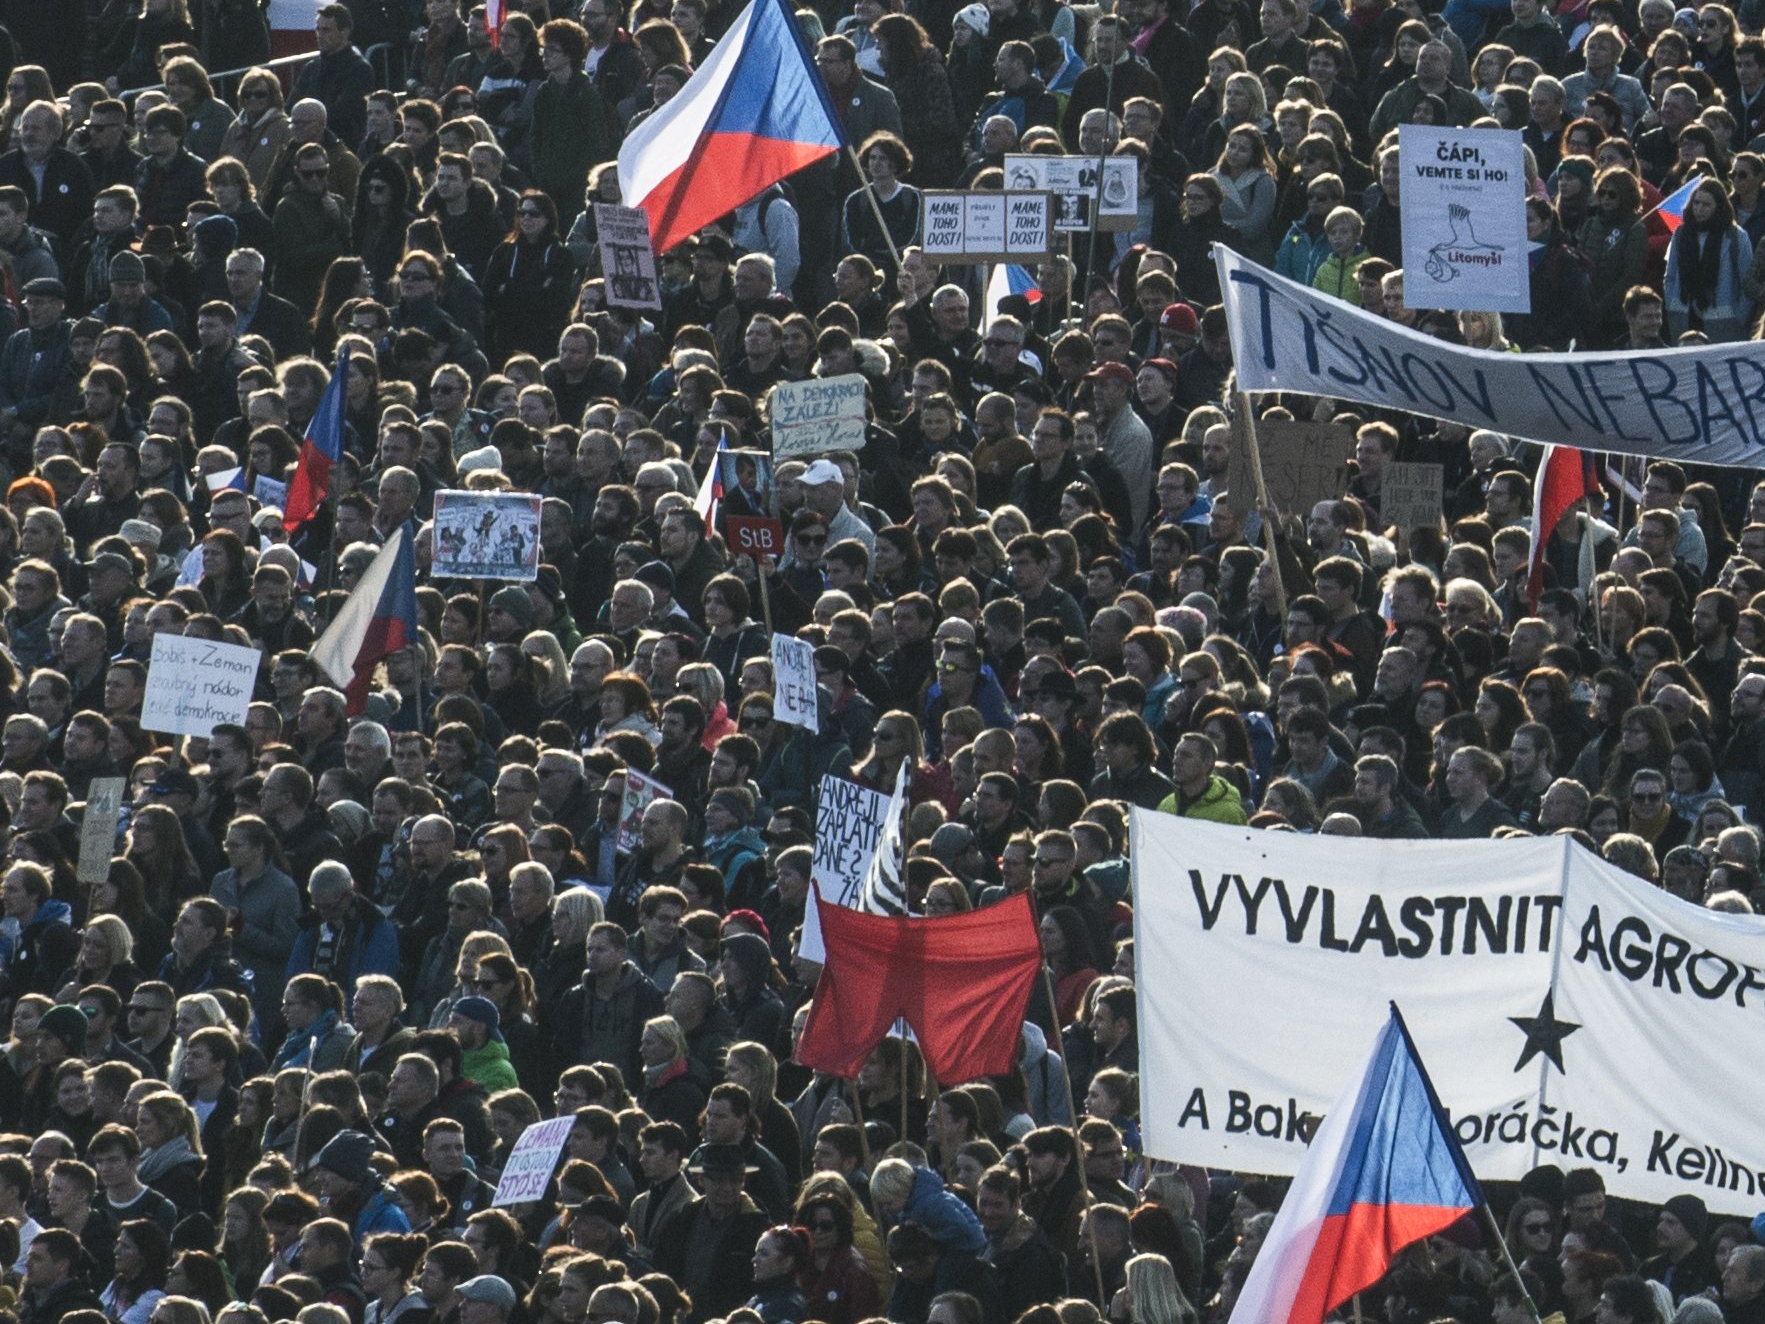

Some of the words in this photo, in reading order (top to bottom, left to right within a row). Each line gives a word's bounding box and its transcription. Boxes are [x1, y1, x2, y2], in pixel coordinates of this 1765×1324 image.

[1436, 141, 1487, 169] ČÁPI,
[1415, 167, 1463, 183] VEMTE
[1466, 169, 1480, 183] SI
[1482, 169, 1509, 185] HO!
[929, 198, 962, 215] MÁME
[1011, 198, 1044, 215] MÁME
[932, 217, 960, 231] TOHO
[1014, 217, 1043, 231] TOHO
[926, 232, 962, 247] DOST!
[1010, 232, 1044, 247] DOST!
[1446, 248, 1503, 268] Litomyšl
[1229, 269, 1499, 424] TIŠNOV
[740, 527, 774, 548] StB
[199, 644, 253, 675] Zeman
[201, 677, 242, 700] nádor
[174, 699, 242, 724] demokracie
[1186, 868, 1562, 961] VYVLASTNIT
[1177, 1086, 1211, 1133] A
